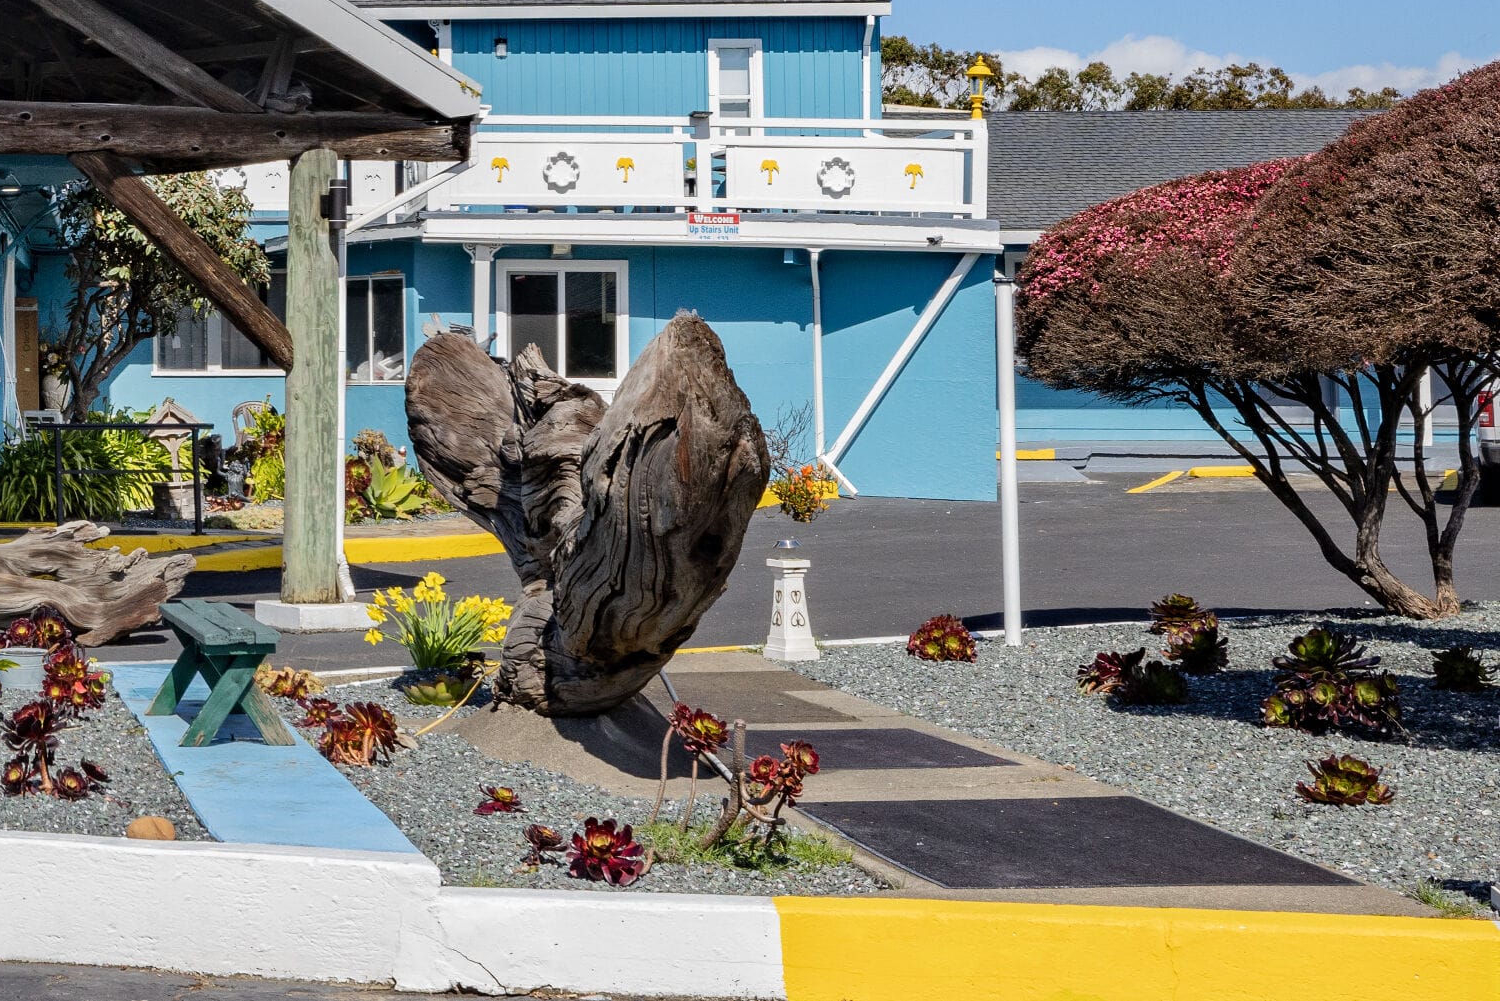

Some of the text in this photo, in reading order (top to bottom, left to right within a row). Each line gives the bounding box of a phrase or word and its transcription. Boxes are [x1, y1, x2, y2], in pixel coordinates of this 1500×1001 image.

[694, 215, 734, 223] WELCOME
[690, 225, 738, 234] Up Stairs Unit
